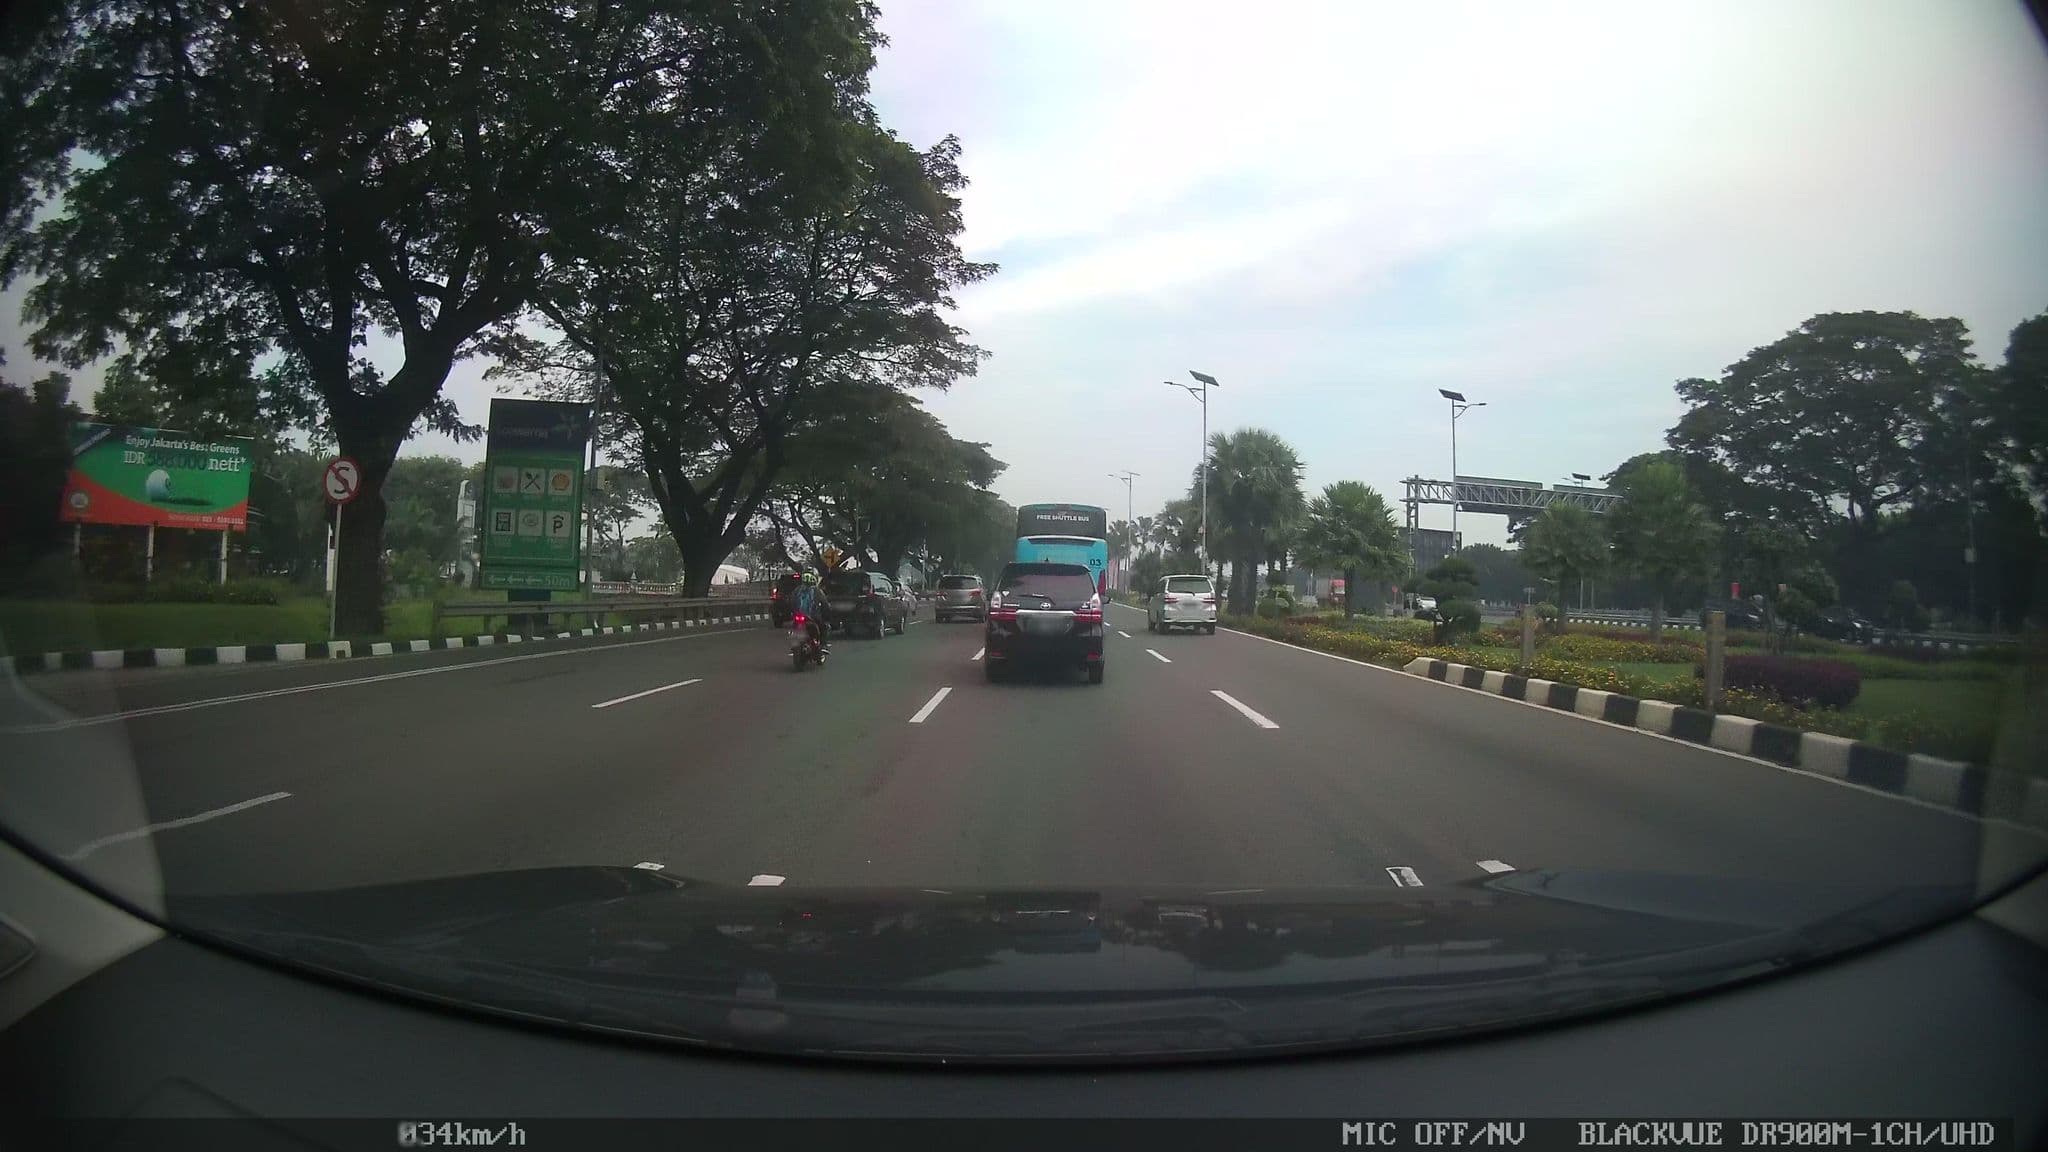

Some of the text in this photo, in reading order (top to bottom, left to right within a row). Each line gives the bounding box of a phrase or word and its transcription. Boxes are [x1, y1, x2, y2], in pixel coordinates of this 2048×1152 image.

[126, 435, 149, 448] Enjoy
[151, 437, 188, 450] Jakarta's
[190, 441, 208, 452] Best
[209, 443, 240, 454] Greens
[124, 450, 145, 464] IDR
[1052, 514, 1077, 522] SHUTTLE
[1089, 558, 1102, 566] 03
